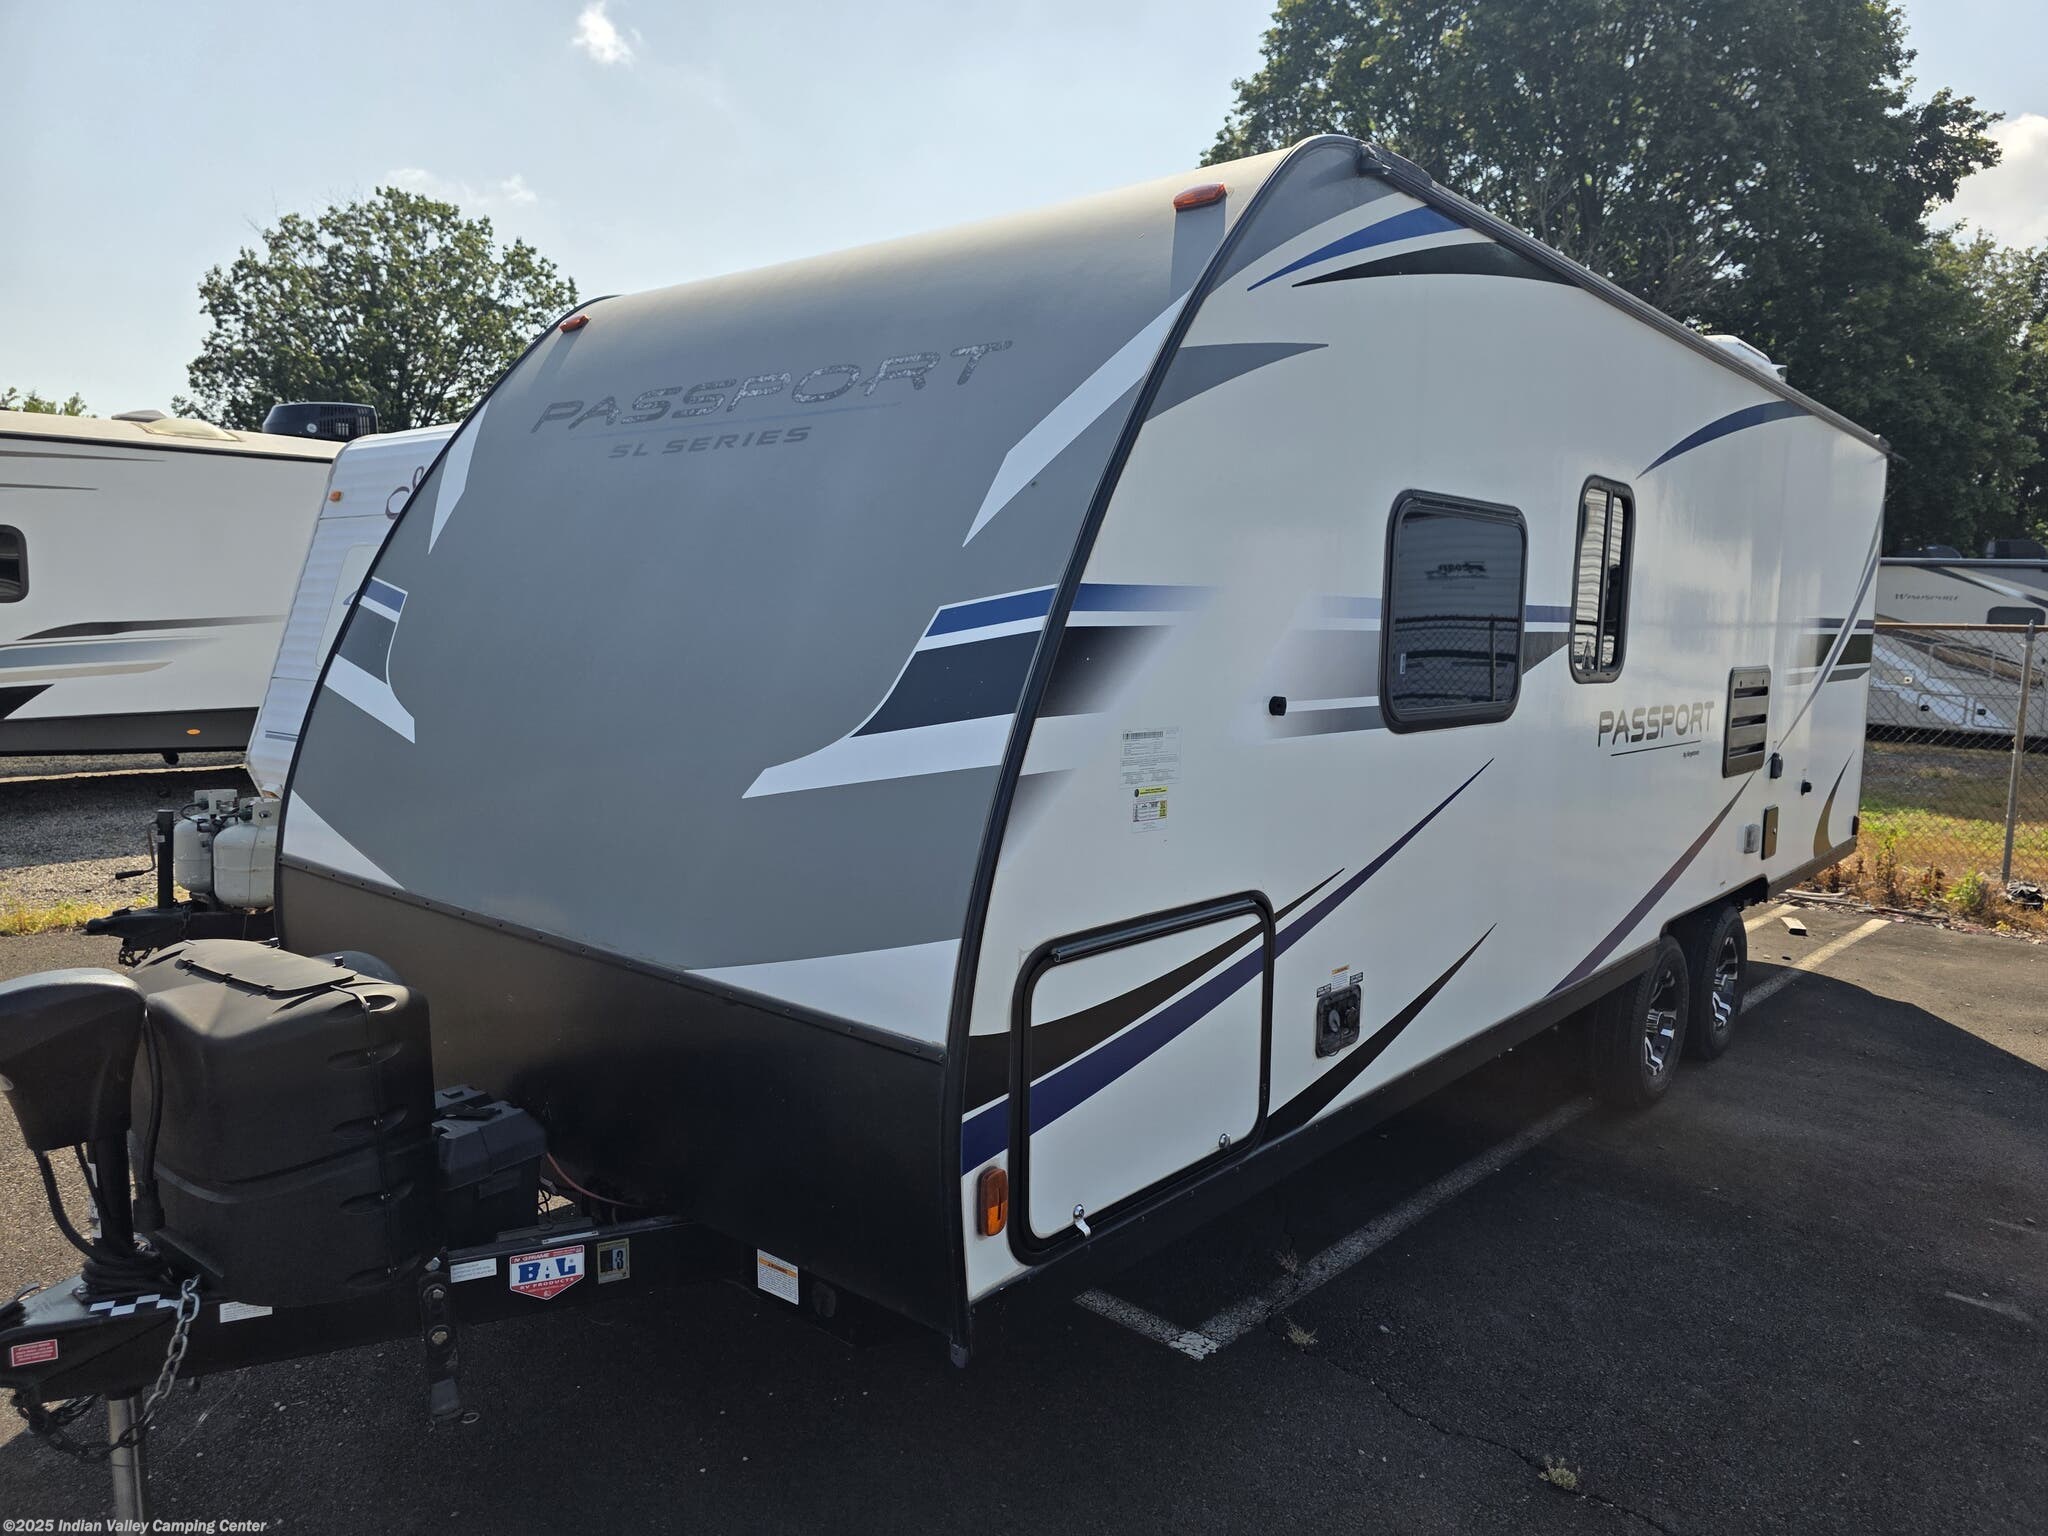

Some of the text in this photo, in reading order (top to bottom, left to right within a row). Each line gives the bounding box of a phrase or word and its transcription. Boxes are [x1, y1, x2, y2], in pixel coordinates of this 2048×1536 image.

[531, 340, 1012, 433] PASSPORT
[608, 426, 812, 459] SL SERIES
[1598, 701, 1715, 747] PASSPORT
[518, 1257, 577, 1283] BAL
